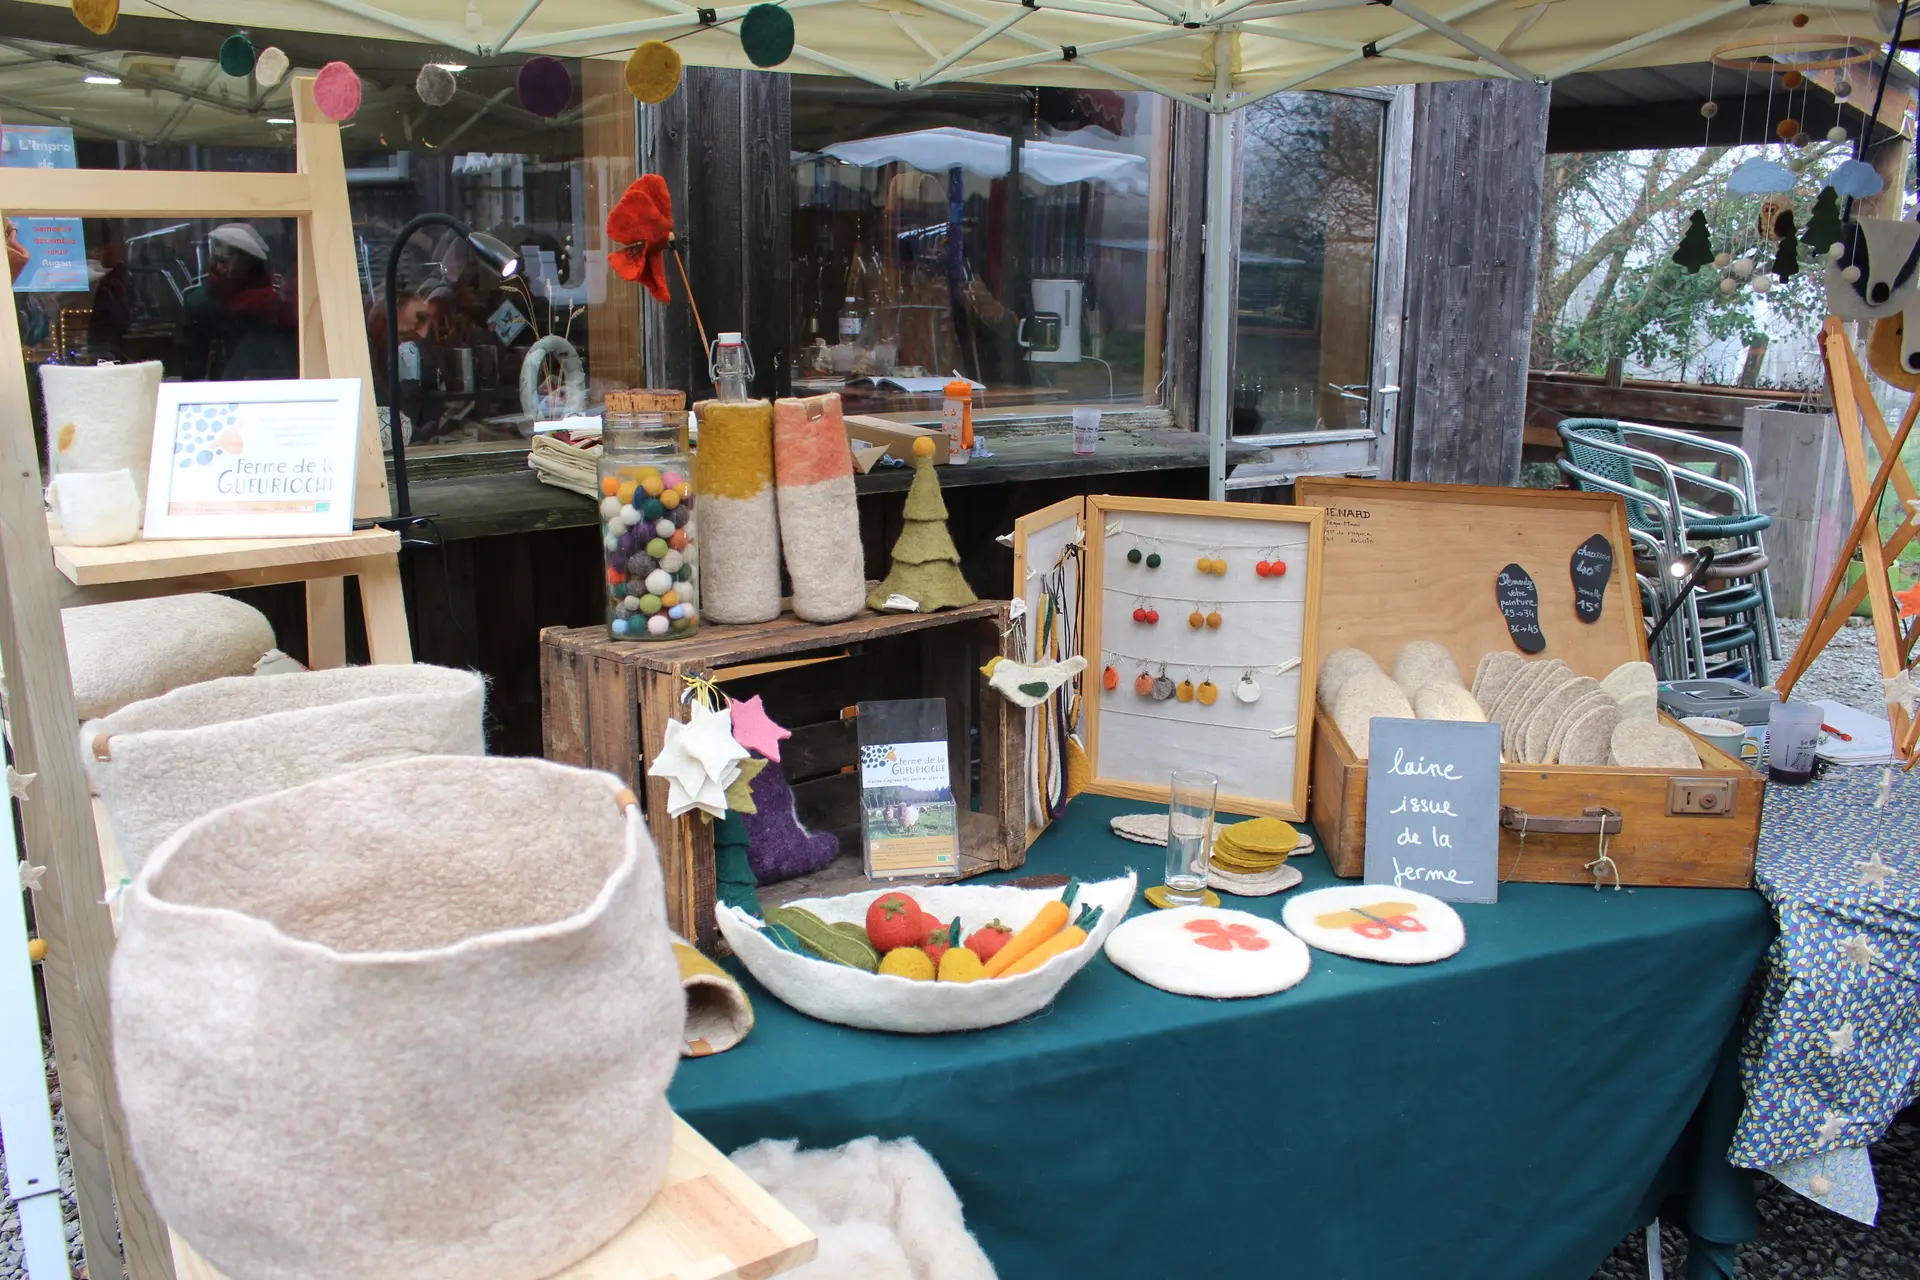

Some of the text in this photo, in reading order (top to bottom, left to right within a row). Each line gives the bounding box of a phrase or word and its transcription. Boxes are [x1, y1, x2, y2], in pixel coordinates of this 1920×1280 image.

[18, 138, 72, 154] L'Impro
[42, 258, 73, 269] Augan
[292, 457, 318, 475] de
[1576, 545, 1611, 561] chausson
[1507, 587, 1528, 597] votre
[1577, 586, 1602, 600] semelle
[1500, 599, 1537, 610] pointure
[1576, 599, 1600, 612] 15€
[924, 756, 936, 764] de
[937, 755, 945, 763] la
[1387, 747, 1463, 780] laine
[1390, 795, 1459, 817] issue
[1396, 825, 1453, 848] de la
[1392, 856, 1474, 889] ferme
